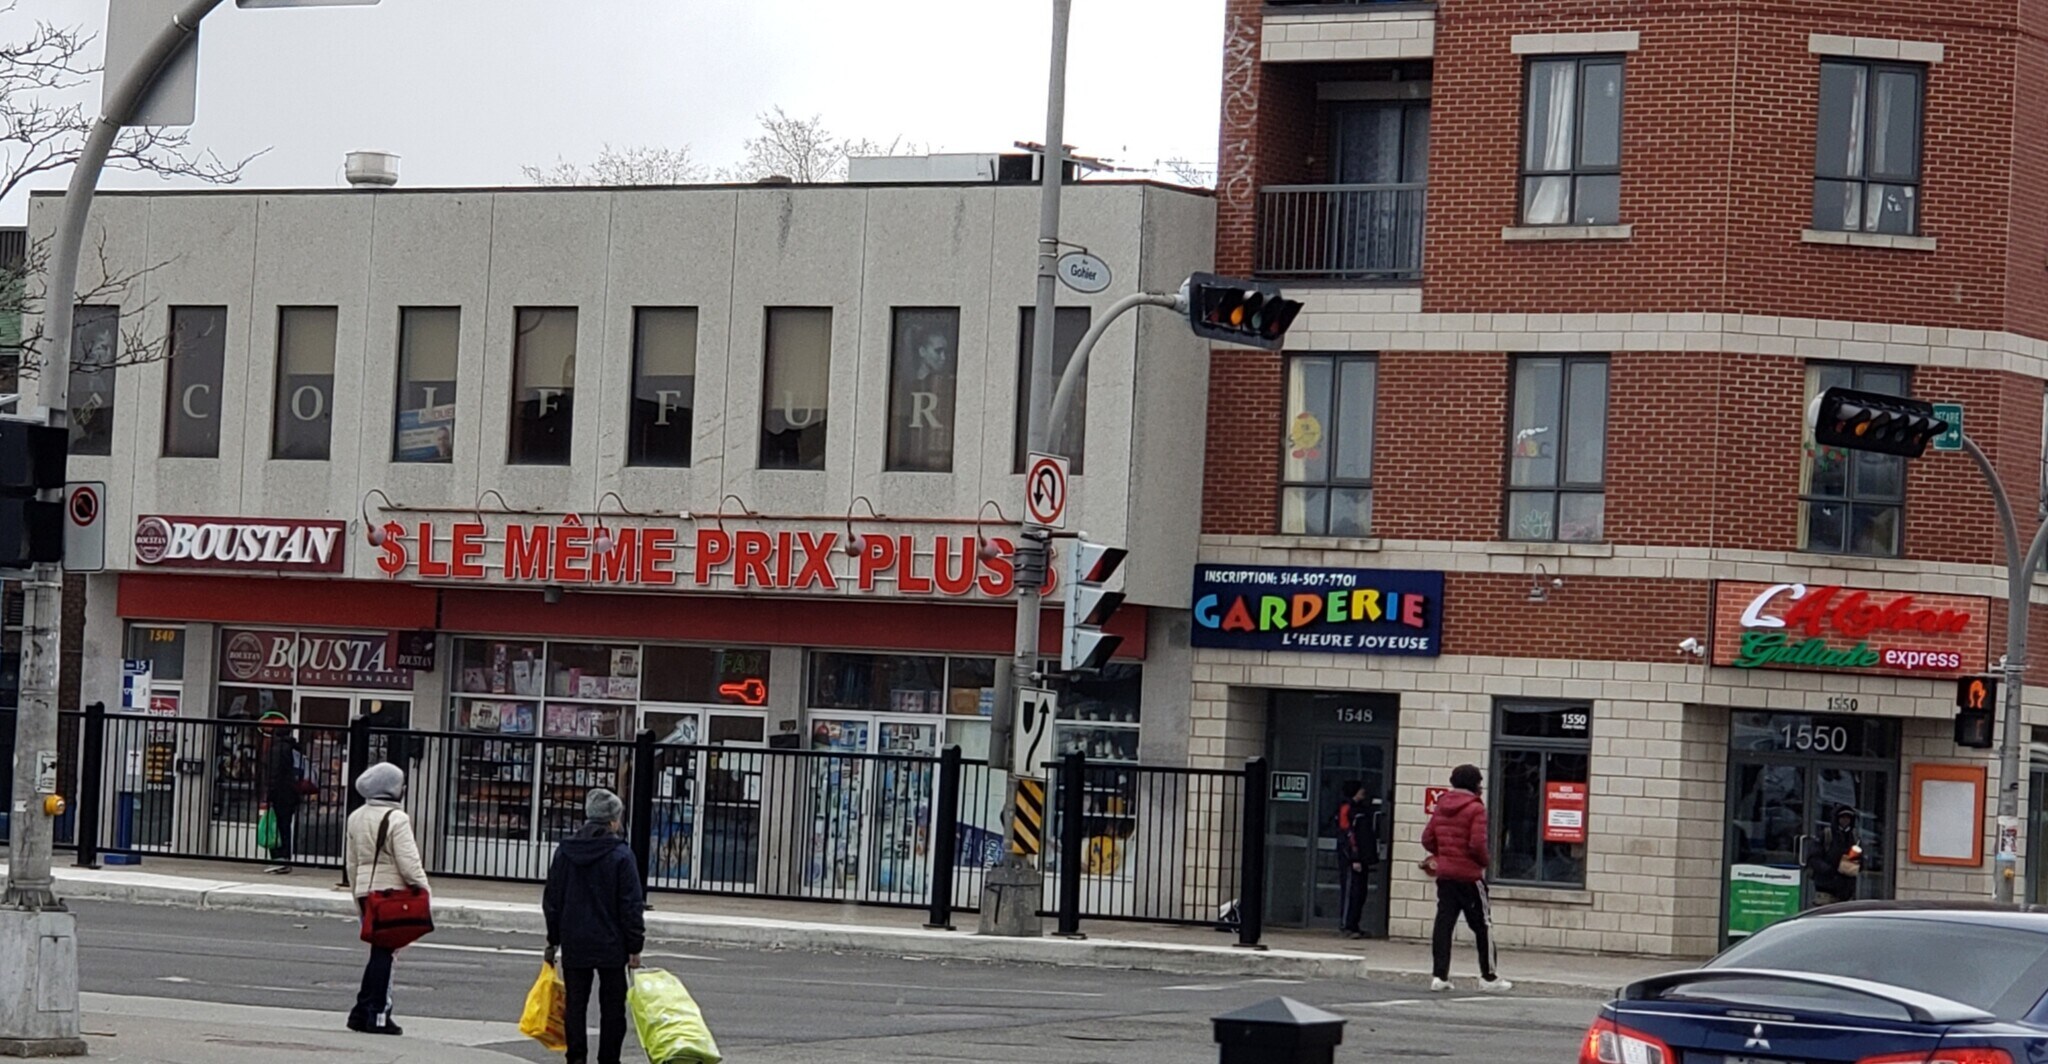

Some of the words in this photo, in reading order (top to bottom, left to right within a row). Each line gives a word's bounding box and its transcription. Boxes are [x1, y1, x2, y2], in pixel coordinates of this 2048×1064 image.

[1070, 264, 1097, 281] Gohier
[166, 523, 342, 564] BOUSTAN
[417, 521, 486, 579] LE
[502, 513, 676, 584] MÊME
[694, 527, 838, 590] PRIX
[857, 532, 1017, 597] PLUS
[1204, 570, 1278, 585] INSCRIPTION:
[1280, 572, 1357, 587] 514-507-7701
[1194, 588, 1425, 632] GARDERIE
[150, 629, 175, 642] 1540
[1282, 634, 1354, 647] L'HEURE
[1358, 635, 1430, 650] JOYEUSE
[266, 636, 407, 674] BOUSTA
[1885, 649, 1960, 669] express
[331, 673, 408, 684] LIBANAISE
[1827, 696, 1859, 712] 1550
[1336, 708, 1373, 722] 1548
[1561, 713, 1587, 725] 1550
[1781, 723, 1848, 752] 1550
